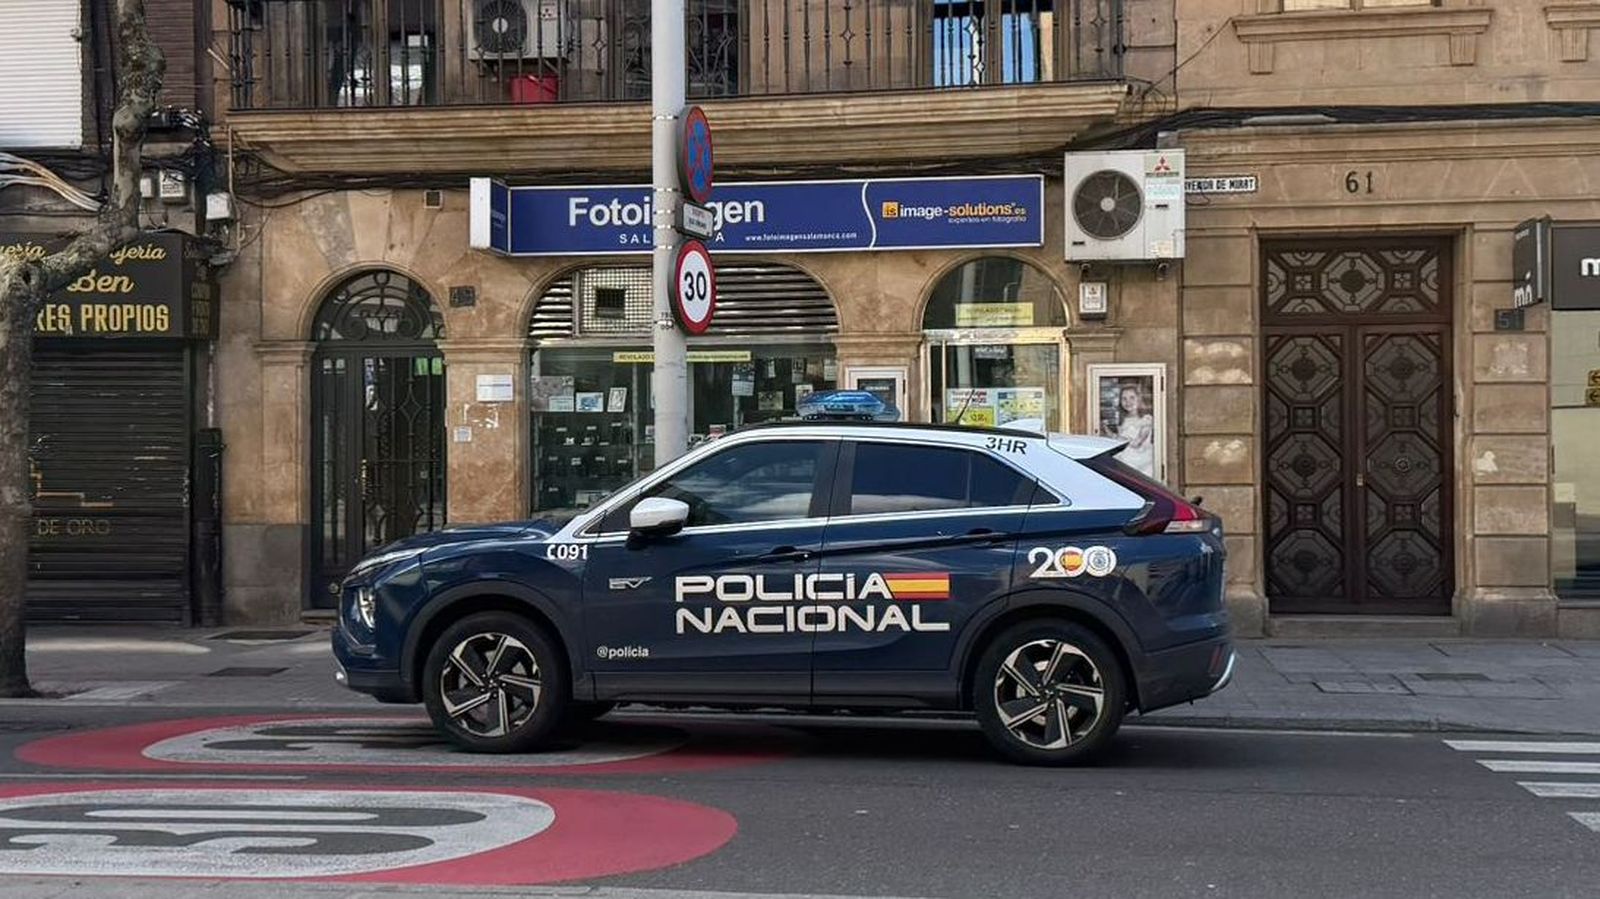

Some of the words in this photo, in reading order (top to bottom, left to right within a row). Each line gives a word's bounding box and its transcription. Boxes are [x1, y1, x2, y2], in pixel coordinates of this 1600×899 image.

[1345, 171, 1374, 194] 61
[569, 196, 765, 232] Fotoigen
[684, 271, 707, 301] 30
[80, 304, 169, 332] PROPIOS
[985, 436, 1027, 455] 3HR
[1027, 545, 1117, 578] 200
[675, 604, 951, 634] NACIONAL
